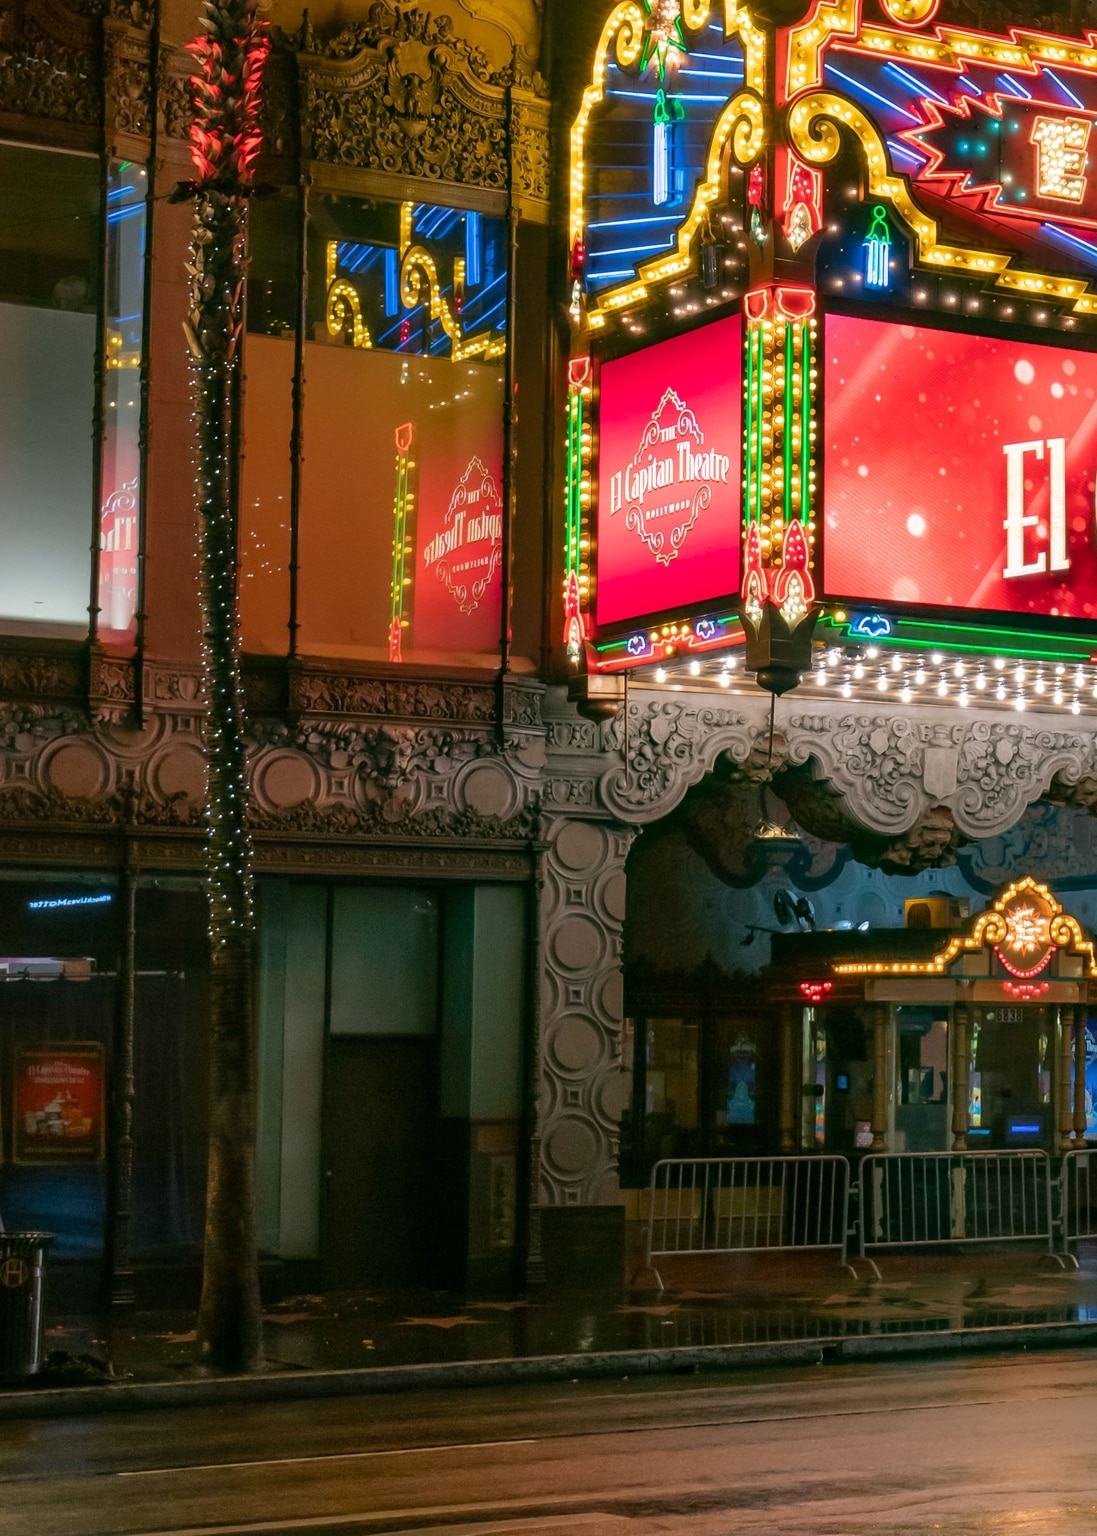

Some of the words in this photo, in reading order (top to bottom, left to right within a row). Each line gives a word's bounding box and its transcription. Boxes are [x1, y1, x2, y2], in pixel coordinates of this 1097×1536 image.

[609, 469, 622, 517] El
[624, 453, 675, 506] Capitan
[675, 440, 731, 485] Theatre
[1003, 437, 1069, 580] El
